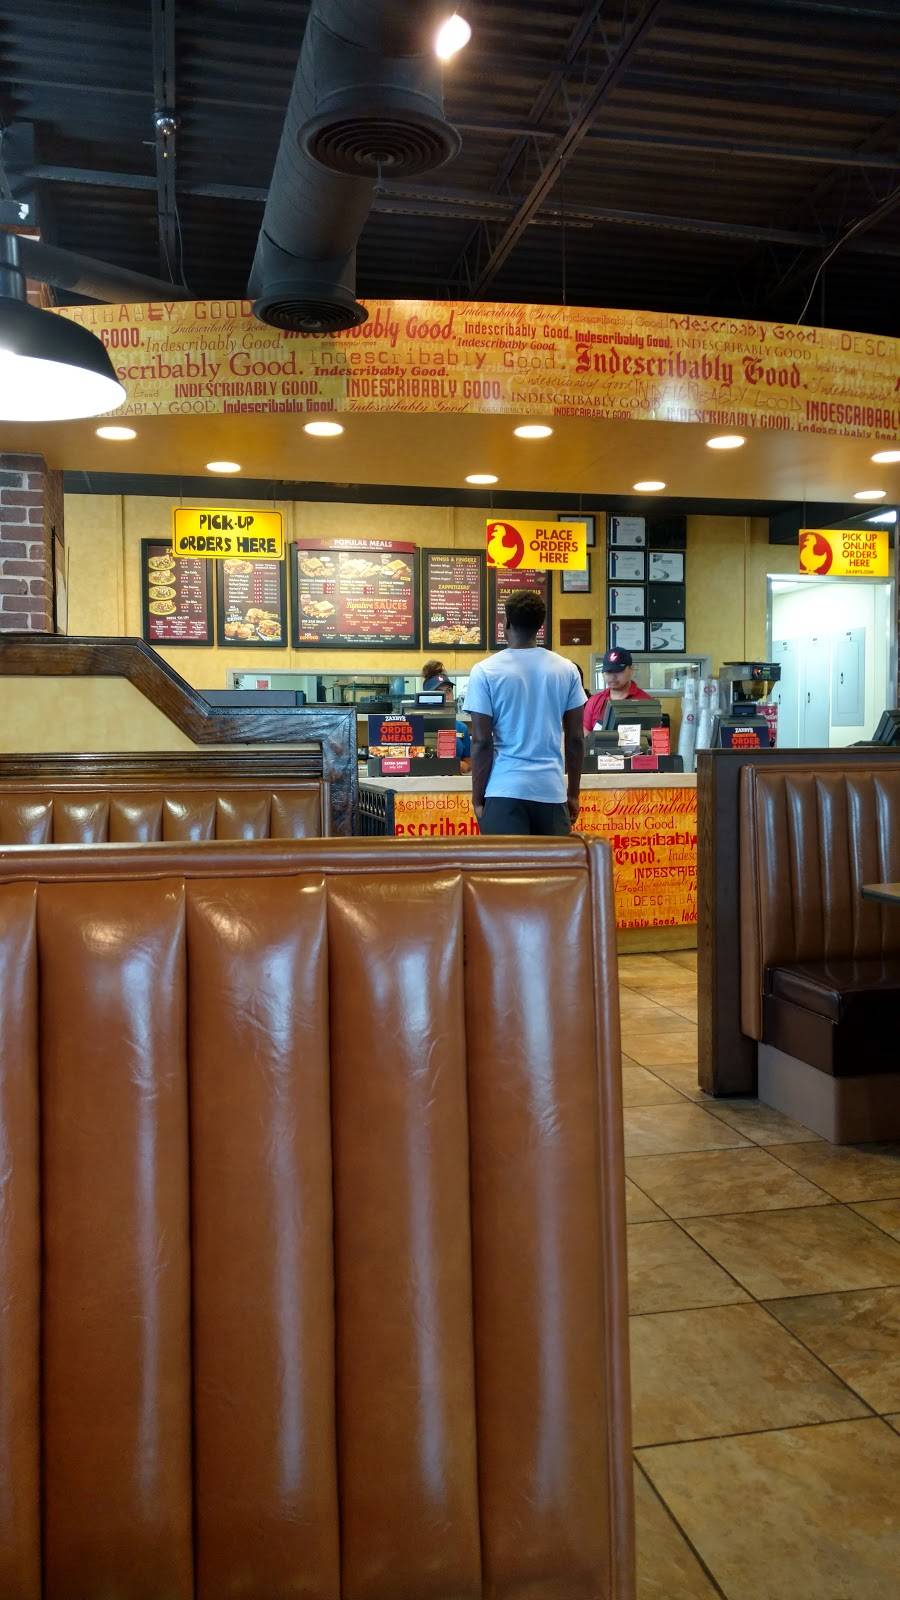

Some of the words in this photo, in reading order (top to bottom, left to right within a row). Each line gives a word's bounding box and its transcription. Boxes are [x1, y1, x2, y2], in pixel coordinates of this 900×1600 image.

[464, 321, 537, 340] Indescribably
[543, 324, 573, 340] Good.
[145, 336, 236, 356] Indescribably
[242, 333, 284, 350] Good.
[457, 338, 528, 351] Indescribably
[575, 329, 644, 350] Indescribably
[229, 351, 303, 377] Good.
[575, 342, 734, 388] Indescribably
[742, 356, 808, 390] Good.
[314, 365, 407, 378] Indescribably
[411, 366, 449, 377] Good.
[174, 381, 278, 399] INDESCRIBABLY
[281, 380, 322, 396] GOOD.
[346, 378, 457, 399] INDESCRIBABLY
[463, 381, 505, 400] GOOD.
[223, 399, 303, 414] Indescribably
[306, 398, 337, 413] Good.
[535, 528, 573, 541] PLACE
[842, 533, 862, 541] PICK
[179, 535, 232, 552] ORDERS
[237, 536, 277, 553] HERE
[369, 540, 393, 548] MEALS
[529, 540, 579, 553] ORDERS
[842, 541, 877, 551] ONLINE
[539, 552, 569, 564] HERE
[842, 550, 878, 559] ORDERS
[849, 559, 871, 568] HERE
[380, 726, 413, 735] ORDER
[381, 734, 414, 743] AHEAD
[645, 816, 678, 830] Good.
